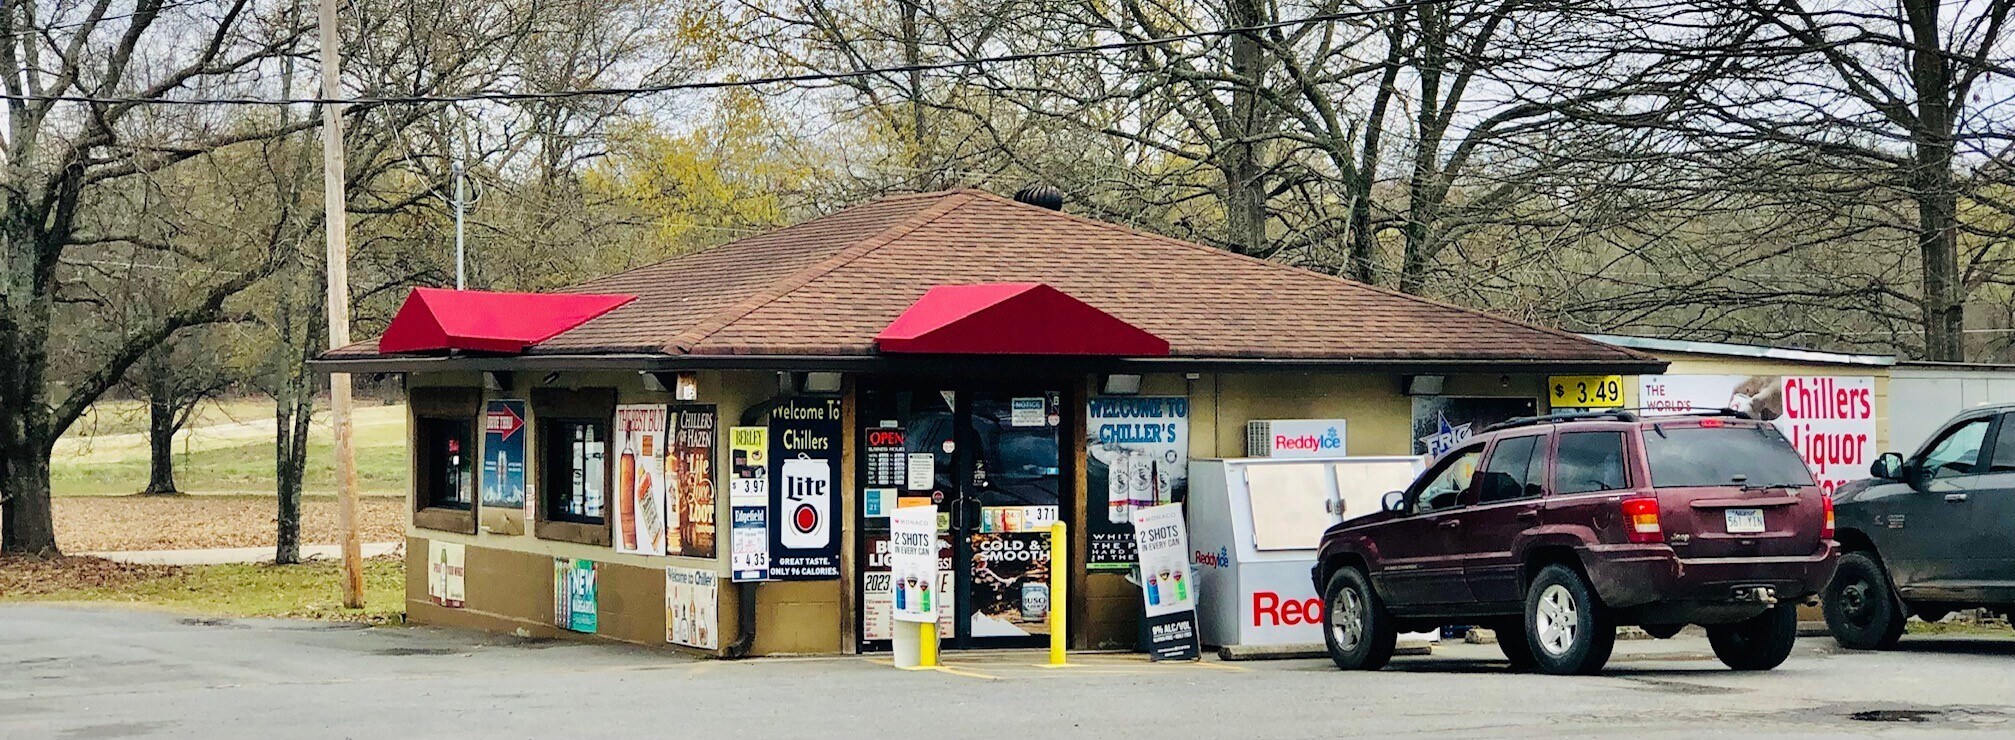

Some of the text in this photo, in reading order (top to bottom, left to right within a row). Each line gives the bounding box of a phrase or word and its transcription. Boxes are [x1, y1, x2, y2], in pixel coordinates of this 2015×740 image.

[1555, 381, 1618, 403] $ 3.49
[1646, 385, 1666, 396] THE
[1786, 378, 1870, 419] Chillers
[827, 400, 840, 420] To
[1089, 398, 1187, 418] WELCOME TO
[1646, 400, 1692, 412] WORLD'S
[648, 410, 666, 432] BUY
[680, 410, 713, 430] CHILLERS
[687, 429, 712, 448] HAZEN
[783, 429, 828, 450] Chillers
[870, 432, 905, 446] OPEN
[1100, 423, 1176, 444] CHILLER'S
[1793, 424, 1866, 474] Liquor
[786, 476, 826, 501] Lite
[1145, 512, 1176, 522] MONACO
[894, 532, 929, 546] 2 SHOTS
[1140, 524, 1178, 543] 2 SHOTS
[901, 547, 916, 555] EVERY
[980, 540, 1040, 551] COLD &
[1149, 541, 1166, 550] EVERY
[1168, 538, 1180, 547] CAN
[805, 557, 830, 565] TASTE.
[982, 550, 1050, 561] SMOOTH
[770, 567, 839, 575] ONLY 96 CALORIES.
[572, 568, 595, 595] NEW
[865, 574, 891, 591] 2023
[1253, 592, 1324, 626] Red
